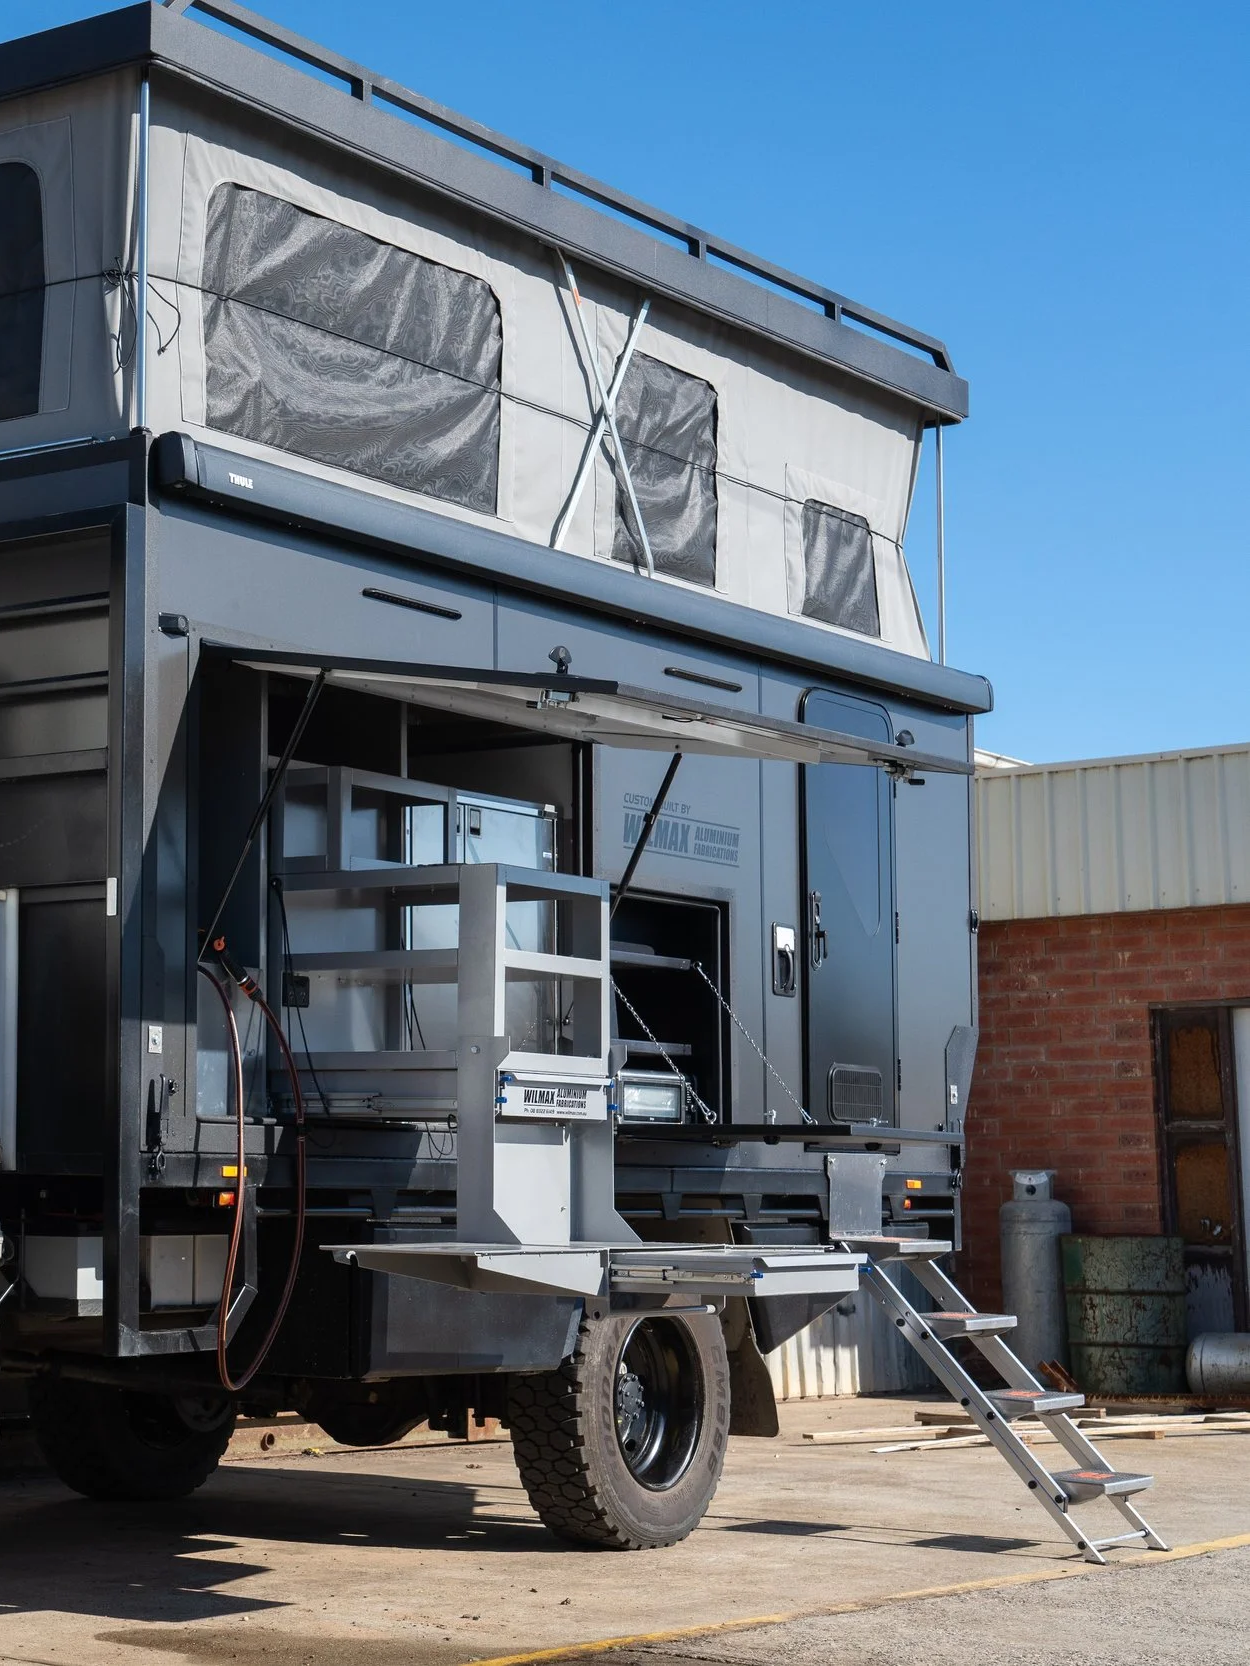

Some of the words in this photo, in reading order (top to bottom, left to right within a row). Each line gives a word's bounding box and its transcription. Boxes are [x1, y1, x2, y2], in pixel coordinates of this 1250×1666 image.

[228, 471, 254, 489] THULE
[661, 801, 679, 812] UILT
[681, 803, 691, 814] BY
[694, 826, 740, 848] ALUMINIUM
[693, 842, 739, 862] FABRICATIONS
[524, 1089, 555, 1104] WILMAX
[556, 1088, 587, 1100] ALUMINIUM
[556, 1099, 587, 1109] FABRICATIONS
